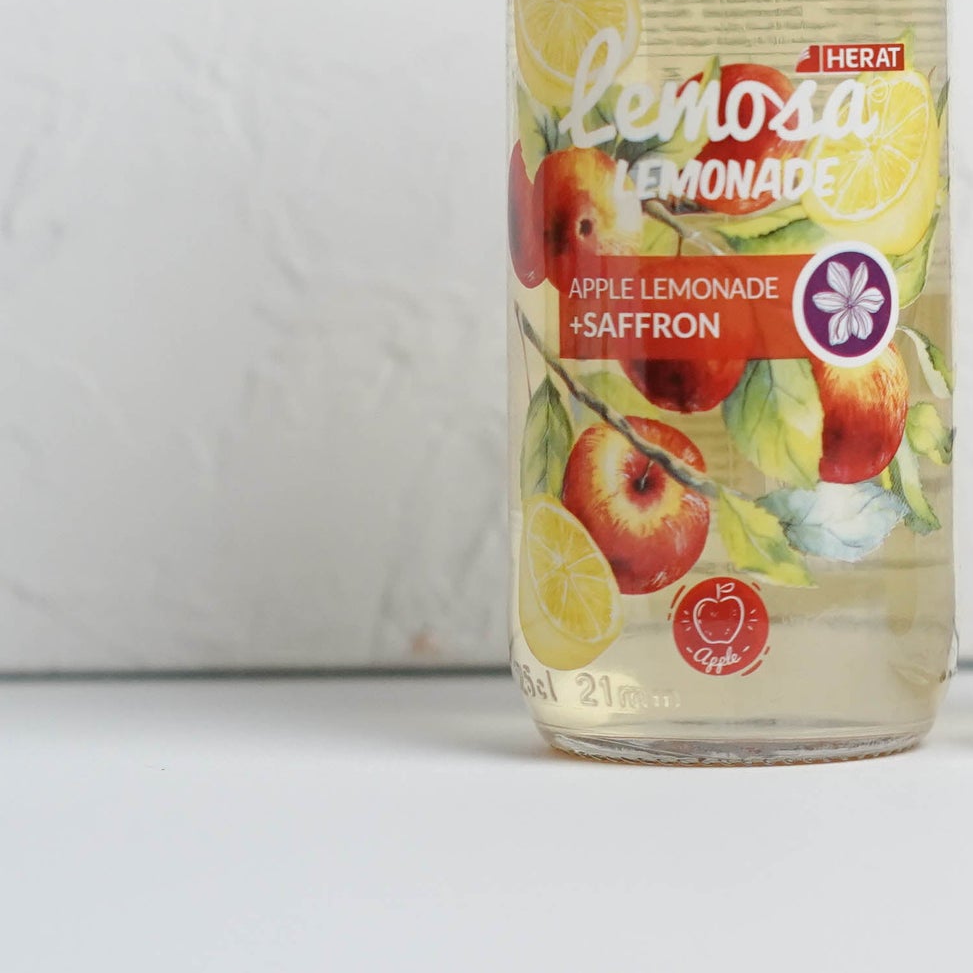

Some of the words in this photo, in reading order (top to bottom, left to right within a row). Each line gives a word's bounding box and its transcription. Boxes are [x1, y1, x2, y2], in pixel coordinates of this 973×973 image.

[826, 46, 902, 69] HERAT
[612, 155, 840, 201] LEMONADE
[568, 276, 635, 300] APPLE
[640, 276, 780, 301] LEMONADE
[569, 311, 721, 339] +SAFFRON
